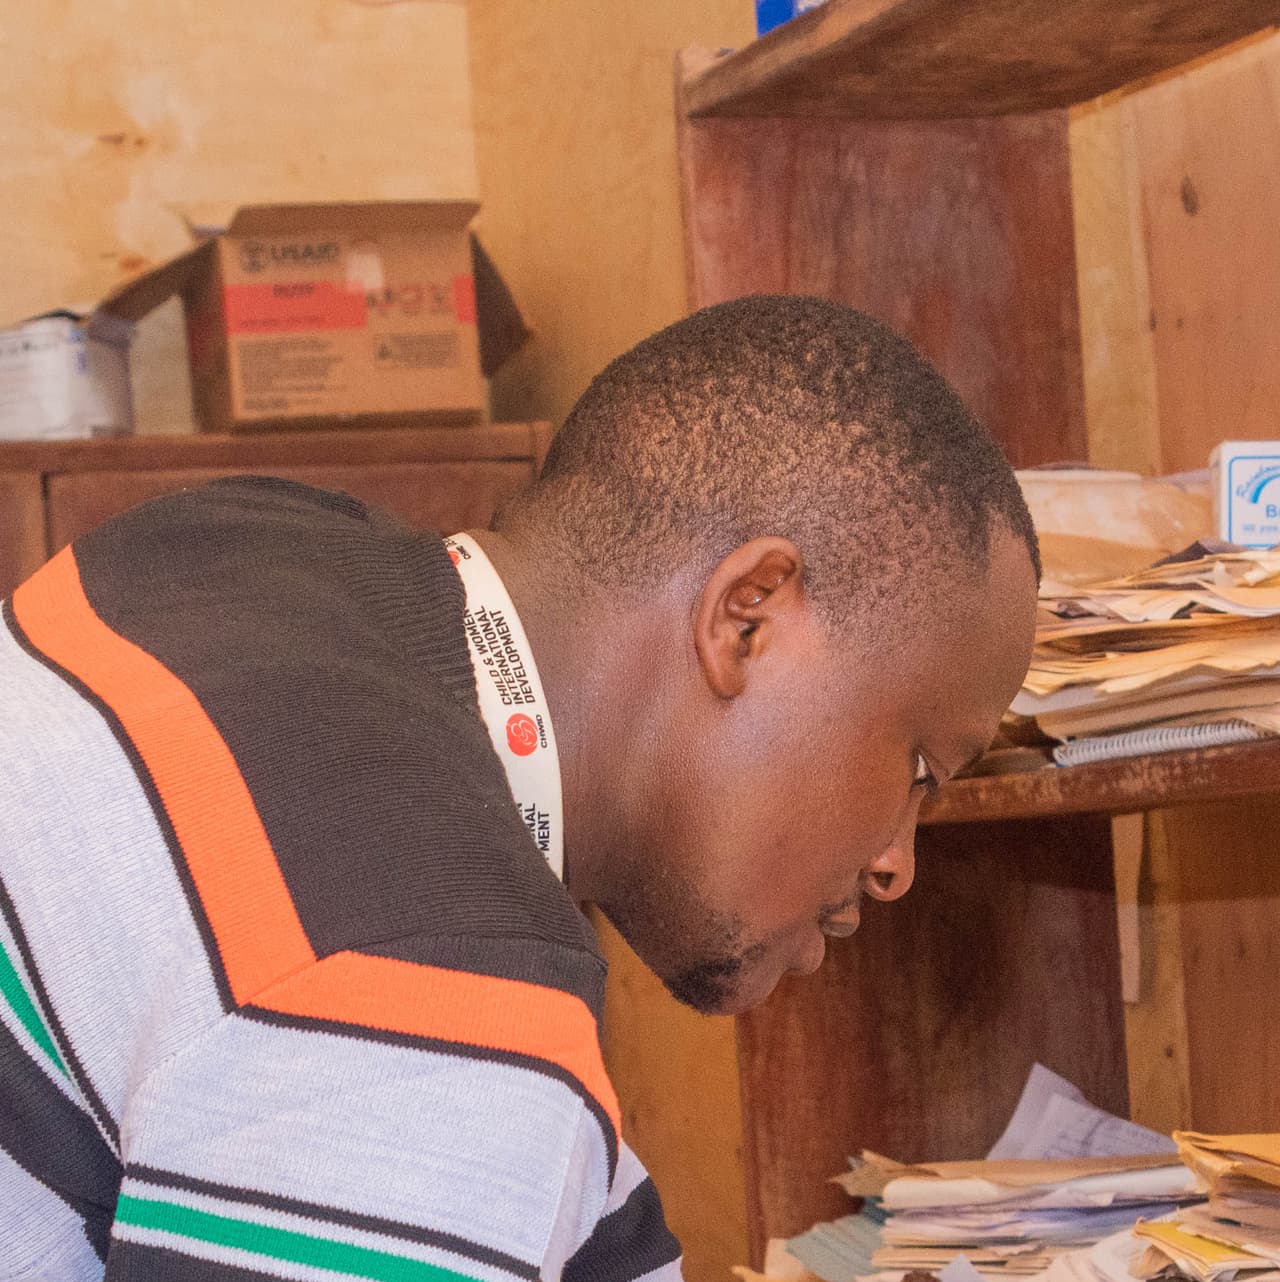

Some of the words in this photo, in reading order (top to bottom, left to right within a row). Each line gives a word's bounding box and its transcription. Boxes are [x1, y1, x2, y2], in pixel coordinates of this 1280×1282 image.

[474, 605, 524, 705] INTERNATIONAL
[489, 609, 536, 704] DEVELOPMENT
[489, 669, 512, 706] CHILD
[535, 714, 548, 749] CHWID
